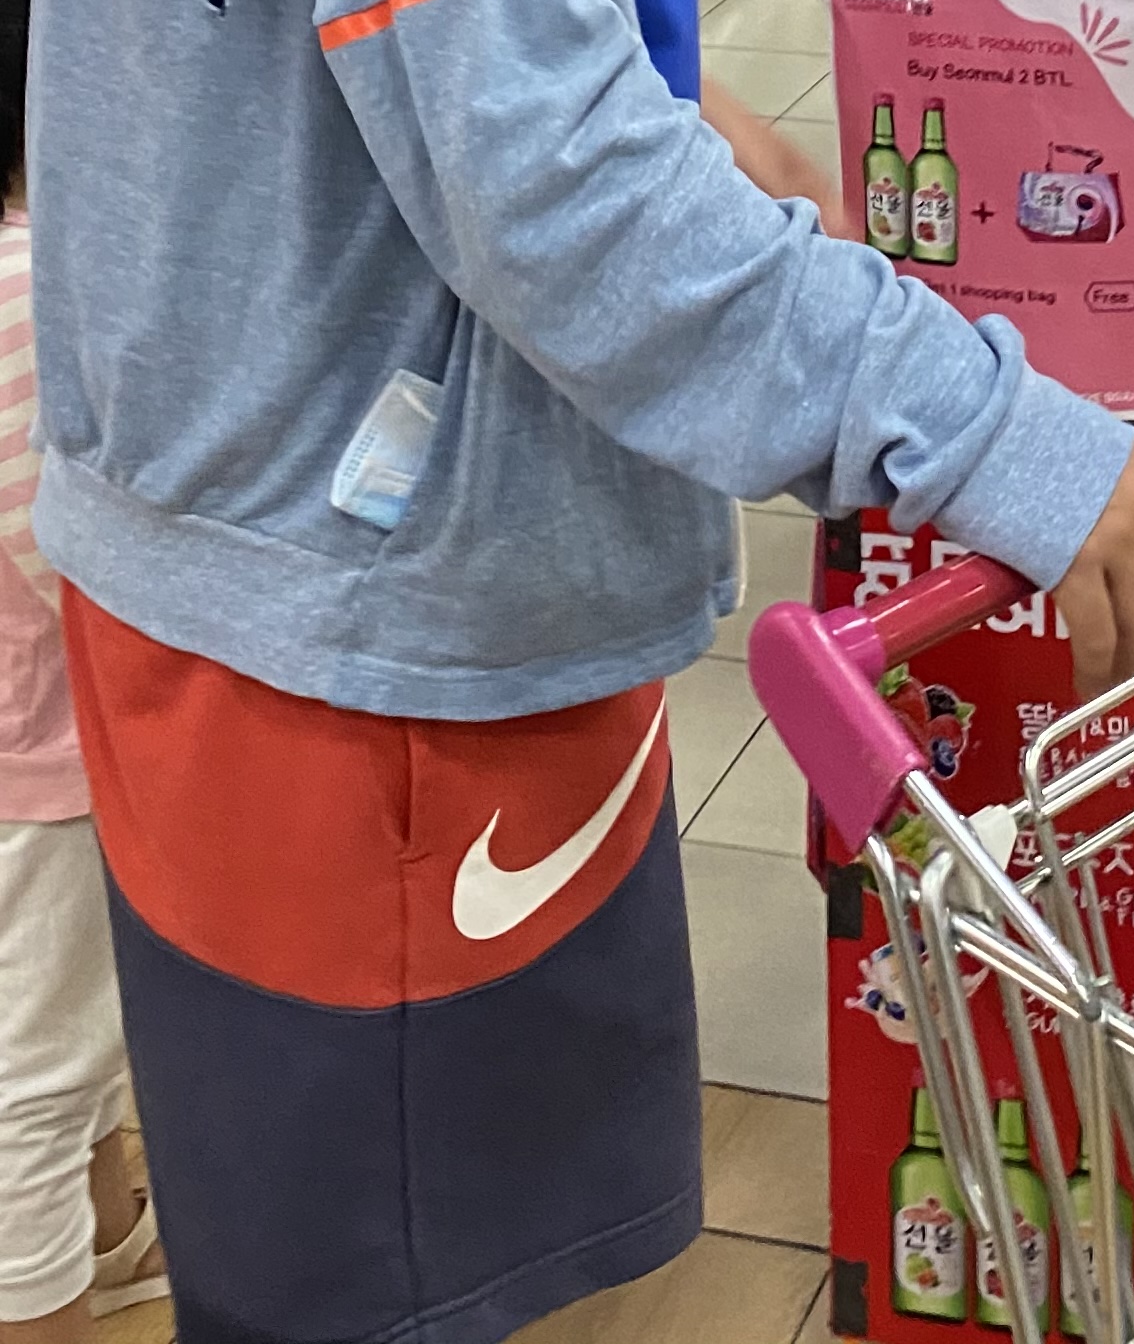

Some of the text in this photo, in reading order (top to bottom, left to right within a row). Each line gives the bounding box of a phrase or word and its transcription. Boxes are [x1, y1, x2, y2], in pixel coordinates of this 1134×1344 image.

[907, 31, 1073, 56] SPECIAL PROMOTION
[907, 60, 1073, 87] Buy Seonmul 2 BTL
[960, 284, 1024, 303] shopping
[1029, 288, 1056, 305] bag
[1092, 289, 1129, 304] Free
